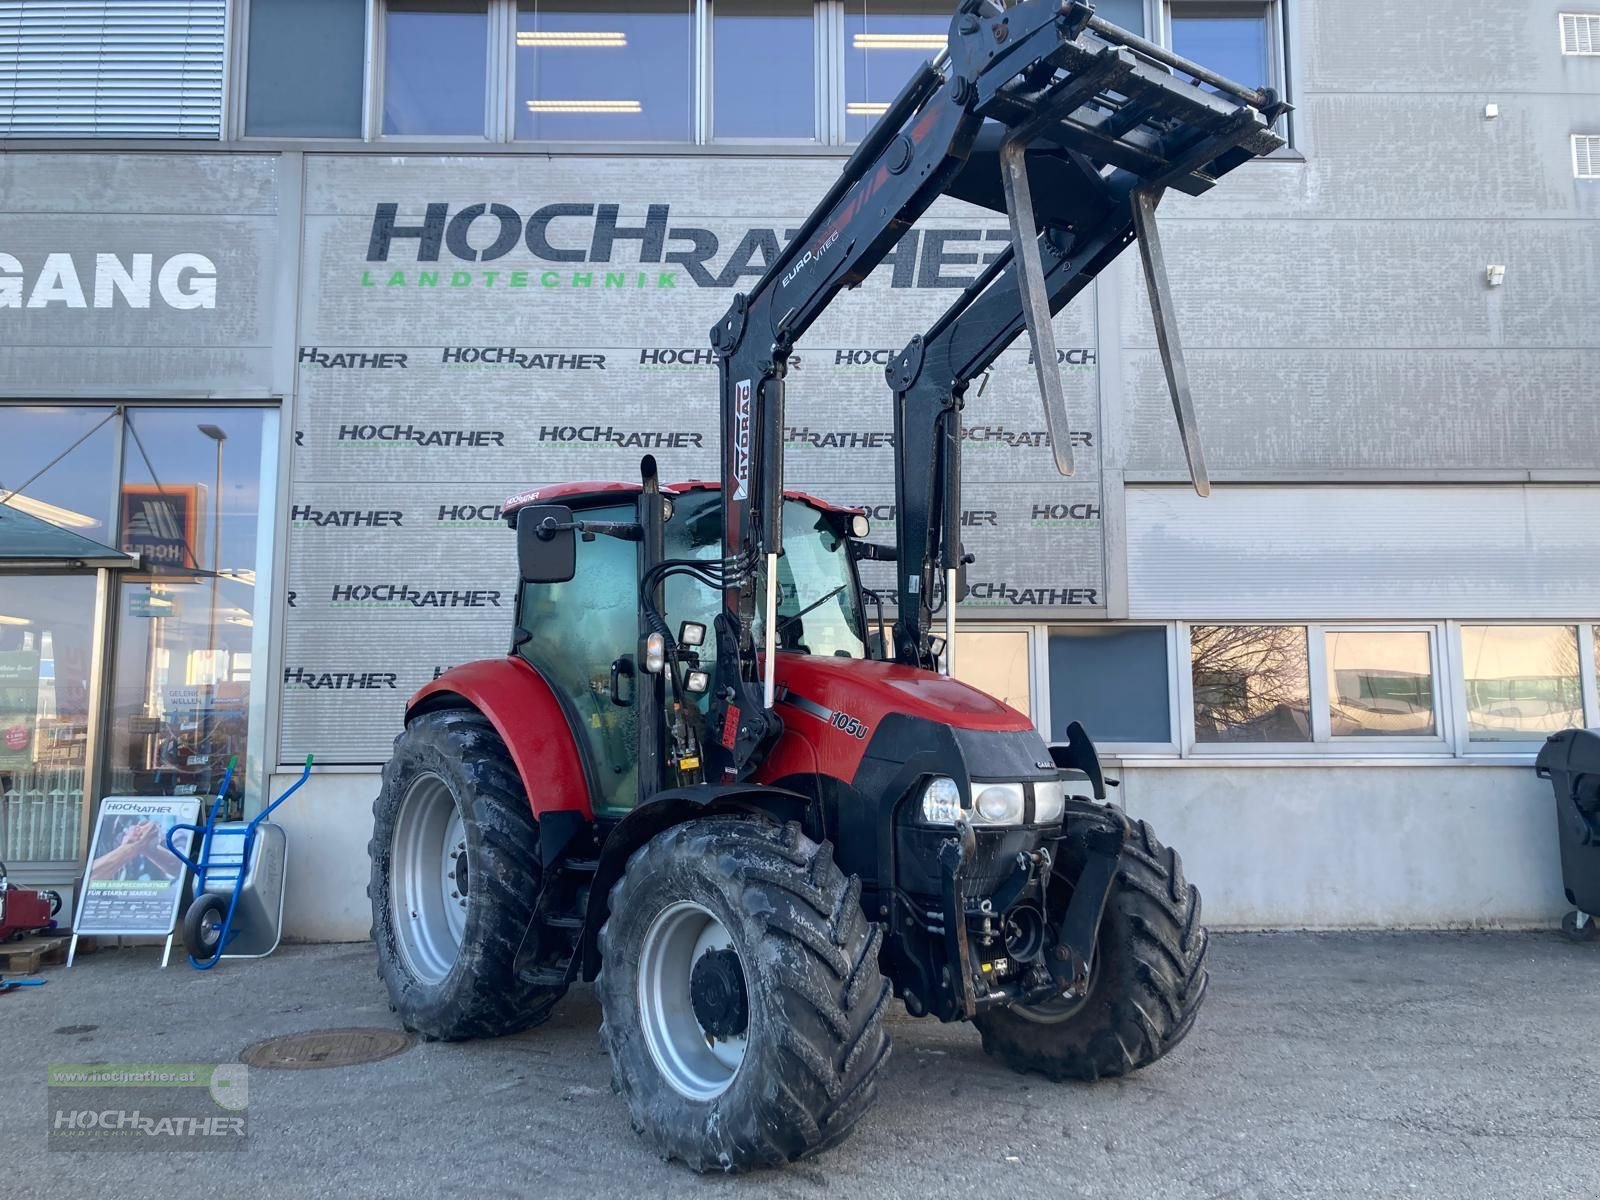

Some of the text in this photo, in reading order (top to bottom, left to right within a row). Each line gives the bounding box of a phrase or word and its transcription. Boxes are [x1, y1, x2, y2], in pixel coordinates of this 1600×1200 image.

[782, 229, 840, 288] EURO VITEC
[361, 271, 677, 289] LANDTECHNIK
[442, 347, 606, 370] HOCHRATHER
[338, 425, 505, 447] HOCHRATHER
[538, 426, 703, 448] HOCHRATHER
[740, 385, 750, 480] HYDRAC
[332, 585, 501, 607] HOCHRATHER
[831, 711, 869, 739] 105U
[107, 803, 172, 814] HOCHRATHER
